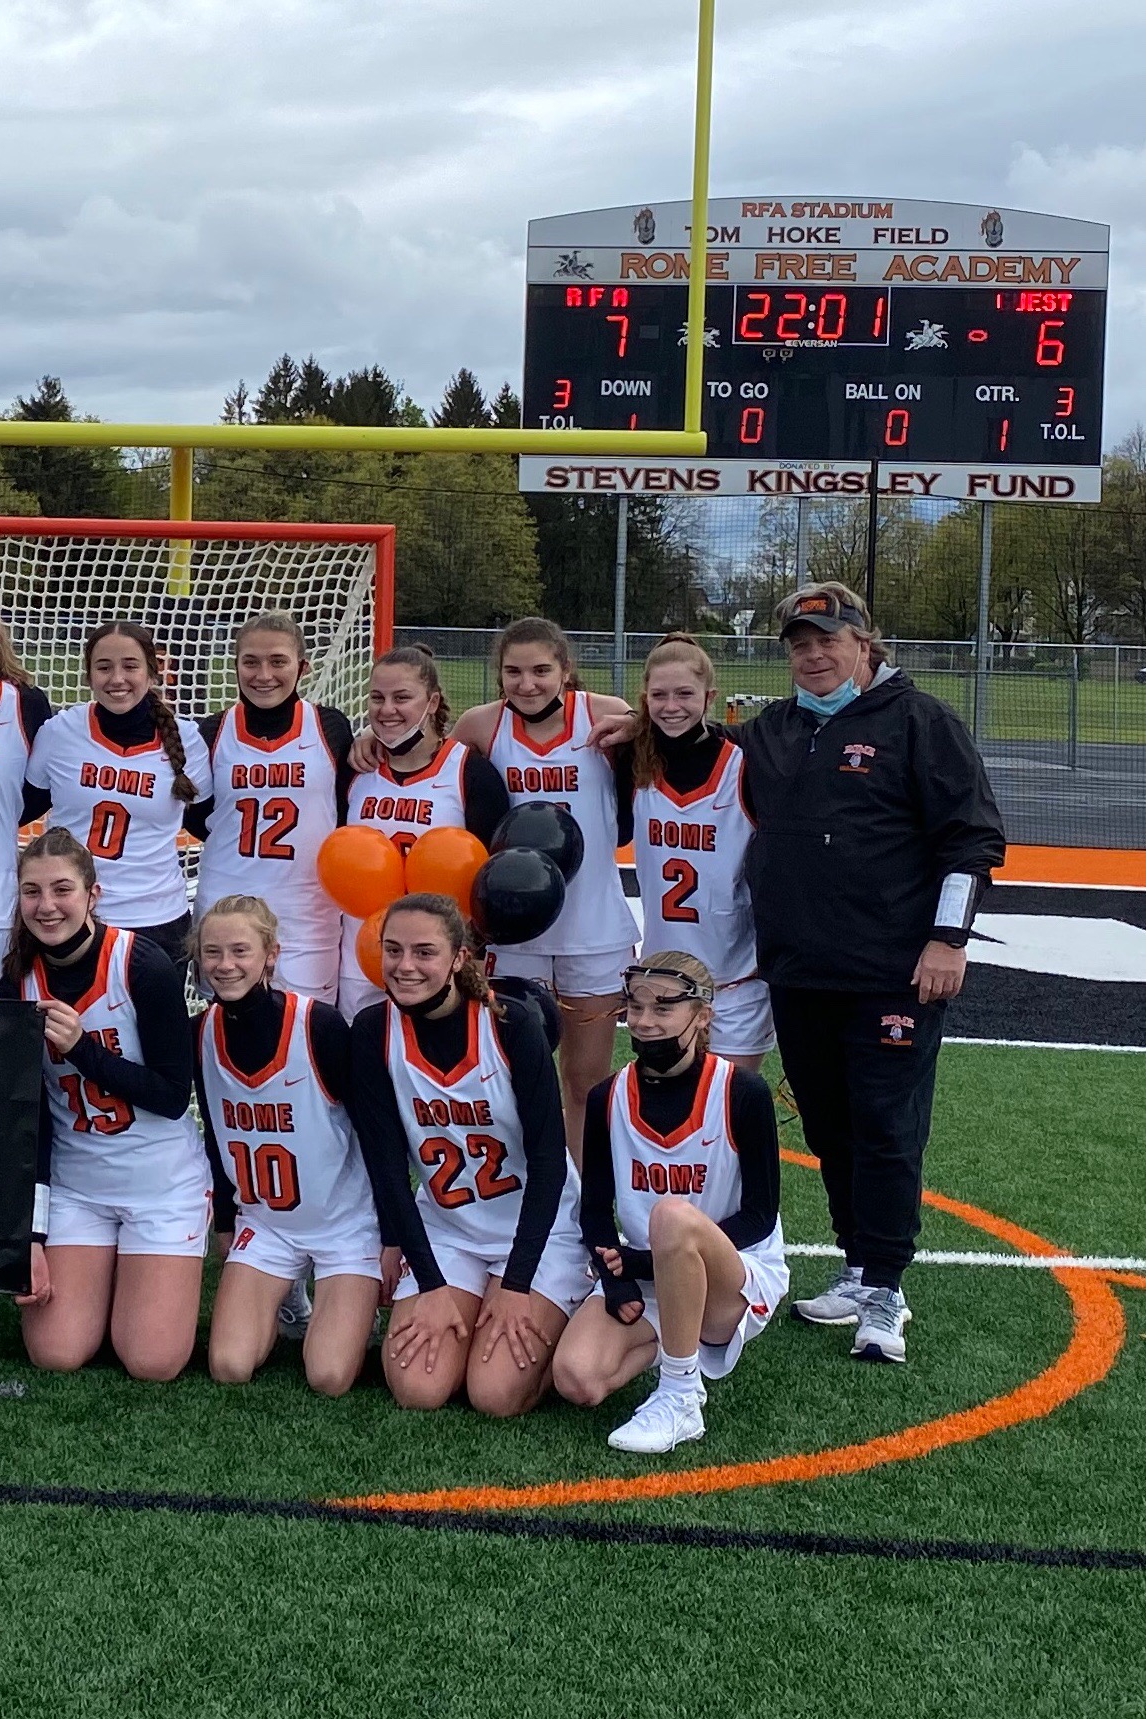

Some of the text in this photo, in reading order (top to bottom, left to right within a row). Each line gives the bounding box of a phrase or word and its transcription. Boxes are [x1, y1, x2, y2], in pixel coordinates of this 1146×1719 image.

[741, 202, 894, 219] RFA STADIUM
[767, 226, 841, 244] HOKE
[873, 227, 949, 244] FIELD
[620, 252, 1082, 284] ROME FREE ACADEMY
[565, 287, 629, 307] RFA
[740, 293, 885, 340] 22:01
[605, 315, 629, 358] 7
[1037, 321, 1065, 366] 6
[553, 379, 572, 409] 3
[601, 380, 652, 396] DOWN
[707, 382, 769, 399] TO GO
[845, 384, 921, 400] BALL ON
[975, 385, 1020, 402] QTR.
[1055, 387, 1074, 416] 3
[740, 407, 764, 444] 0
[885, 410, 909, 446] 0
[1000, 419, 1009, 452] 1
[1040, 424, 1085, 440] T.O.L.
[545, 466, 1076, 498] STEVENS KINGSLEY FUND
[779, 462, 820, 470] DONATED
[81, 762, 155, 799] ROME
[231, 762, 305, 790] ROME
[506, 765, 579, 793] ROME
[360, 796, 433, 825] ROME
[86, 800, 131, 861] 0
[235, 797, 300, 860] 12
[649, 818, 717, 852] ROME
[662, 858, 699, 923] 2
[222, 1098, 295, 1133] ROME
[412, 1097, 494, 1127] ROME
[227, 1141, 301, 1211] 10
[418, 1133, 522, 1209] 22
[631, 1158, 708, 1195] ROME
